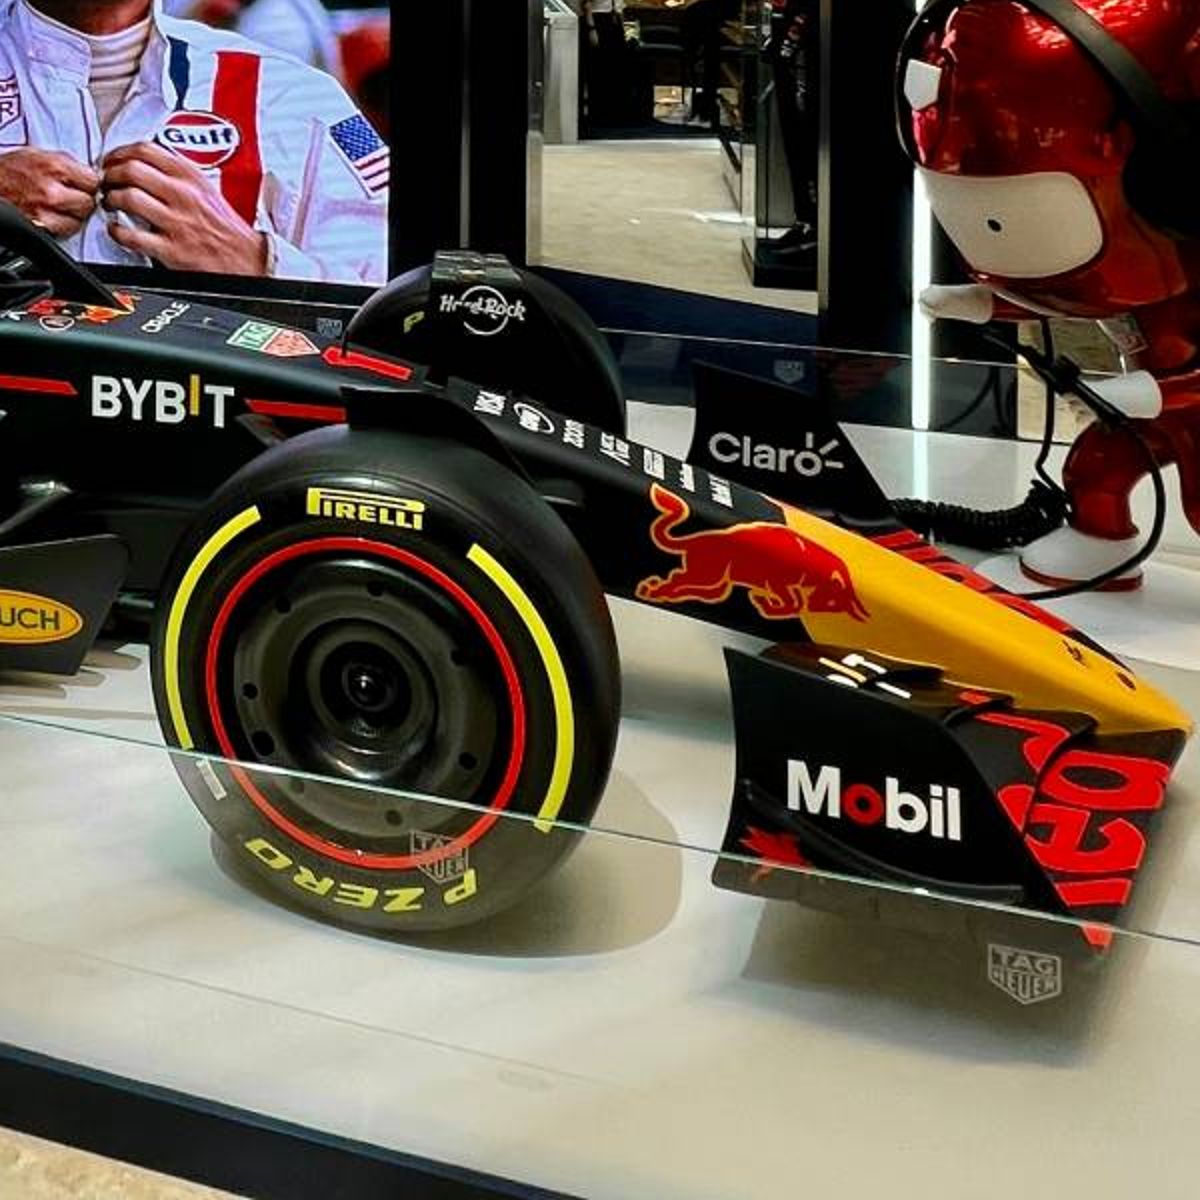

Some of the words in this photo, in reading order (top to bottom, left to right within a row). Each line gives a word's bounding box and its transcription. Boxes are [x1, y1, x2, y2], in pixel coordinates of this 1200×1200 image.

[164, 126, 233, 146] Gulf
[483, 297, 527, 321] Rock
[91, 374, 235, 428] BYBIT
[708, 432, 826, 478] Claro
[306, 487, 426, 531] PIRELLI
[786, 758, 962, 842] Mobil
[994, 949, 1056, 976] TAG
